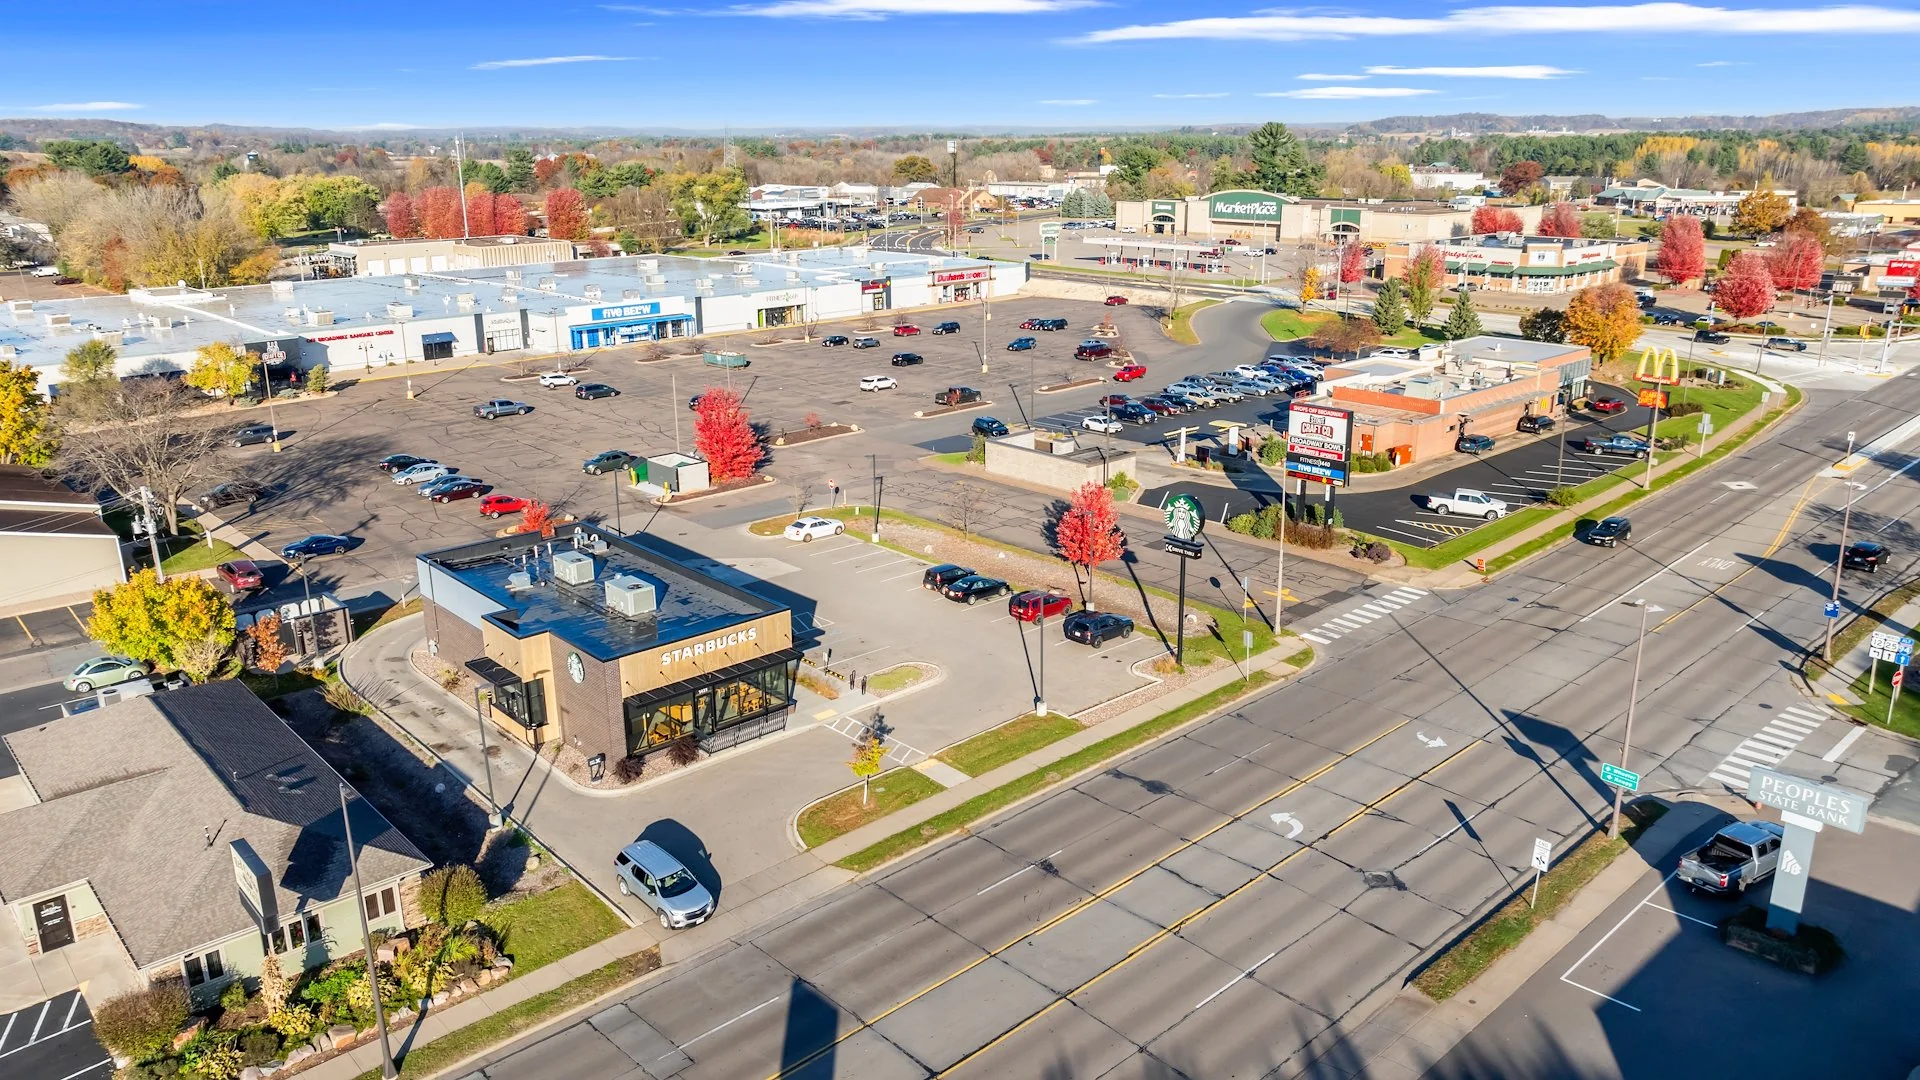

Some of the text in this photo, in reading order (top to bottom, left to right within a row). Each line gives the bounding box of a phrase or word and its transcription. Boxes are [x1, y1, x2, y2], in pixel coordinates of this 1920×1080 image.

[1214, 201, 1277, 215] MarketPlace
[937, 273, 965, 283] Dunham's
[602, 308, 623, 319] five
[1317, 409, 1345, 418] BROADWAY
[1301, 422, 1321, 434] CRAFT
[1290, 437, 1323, 448] BROADWAY
[1323, 442, 1342, 452] BOWL
[1298, 464, 1312, 472] five
[1172, 546, 1184, 554] DRIVE
[660, 627, 757, 666] STARBUCKS
[1873, 638, 1883, 647] 12
[1885, 640, 1897, 650] 25
[1761, 775, 1851, 814] PEOPLES
[1758, 790, 1849, 826] STATE BANK
